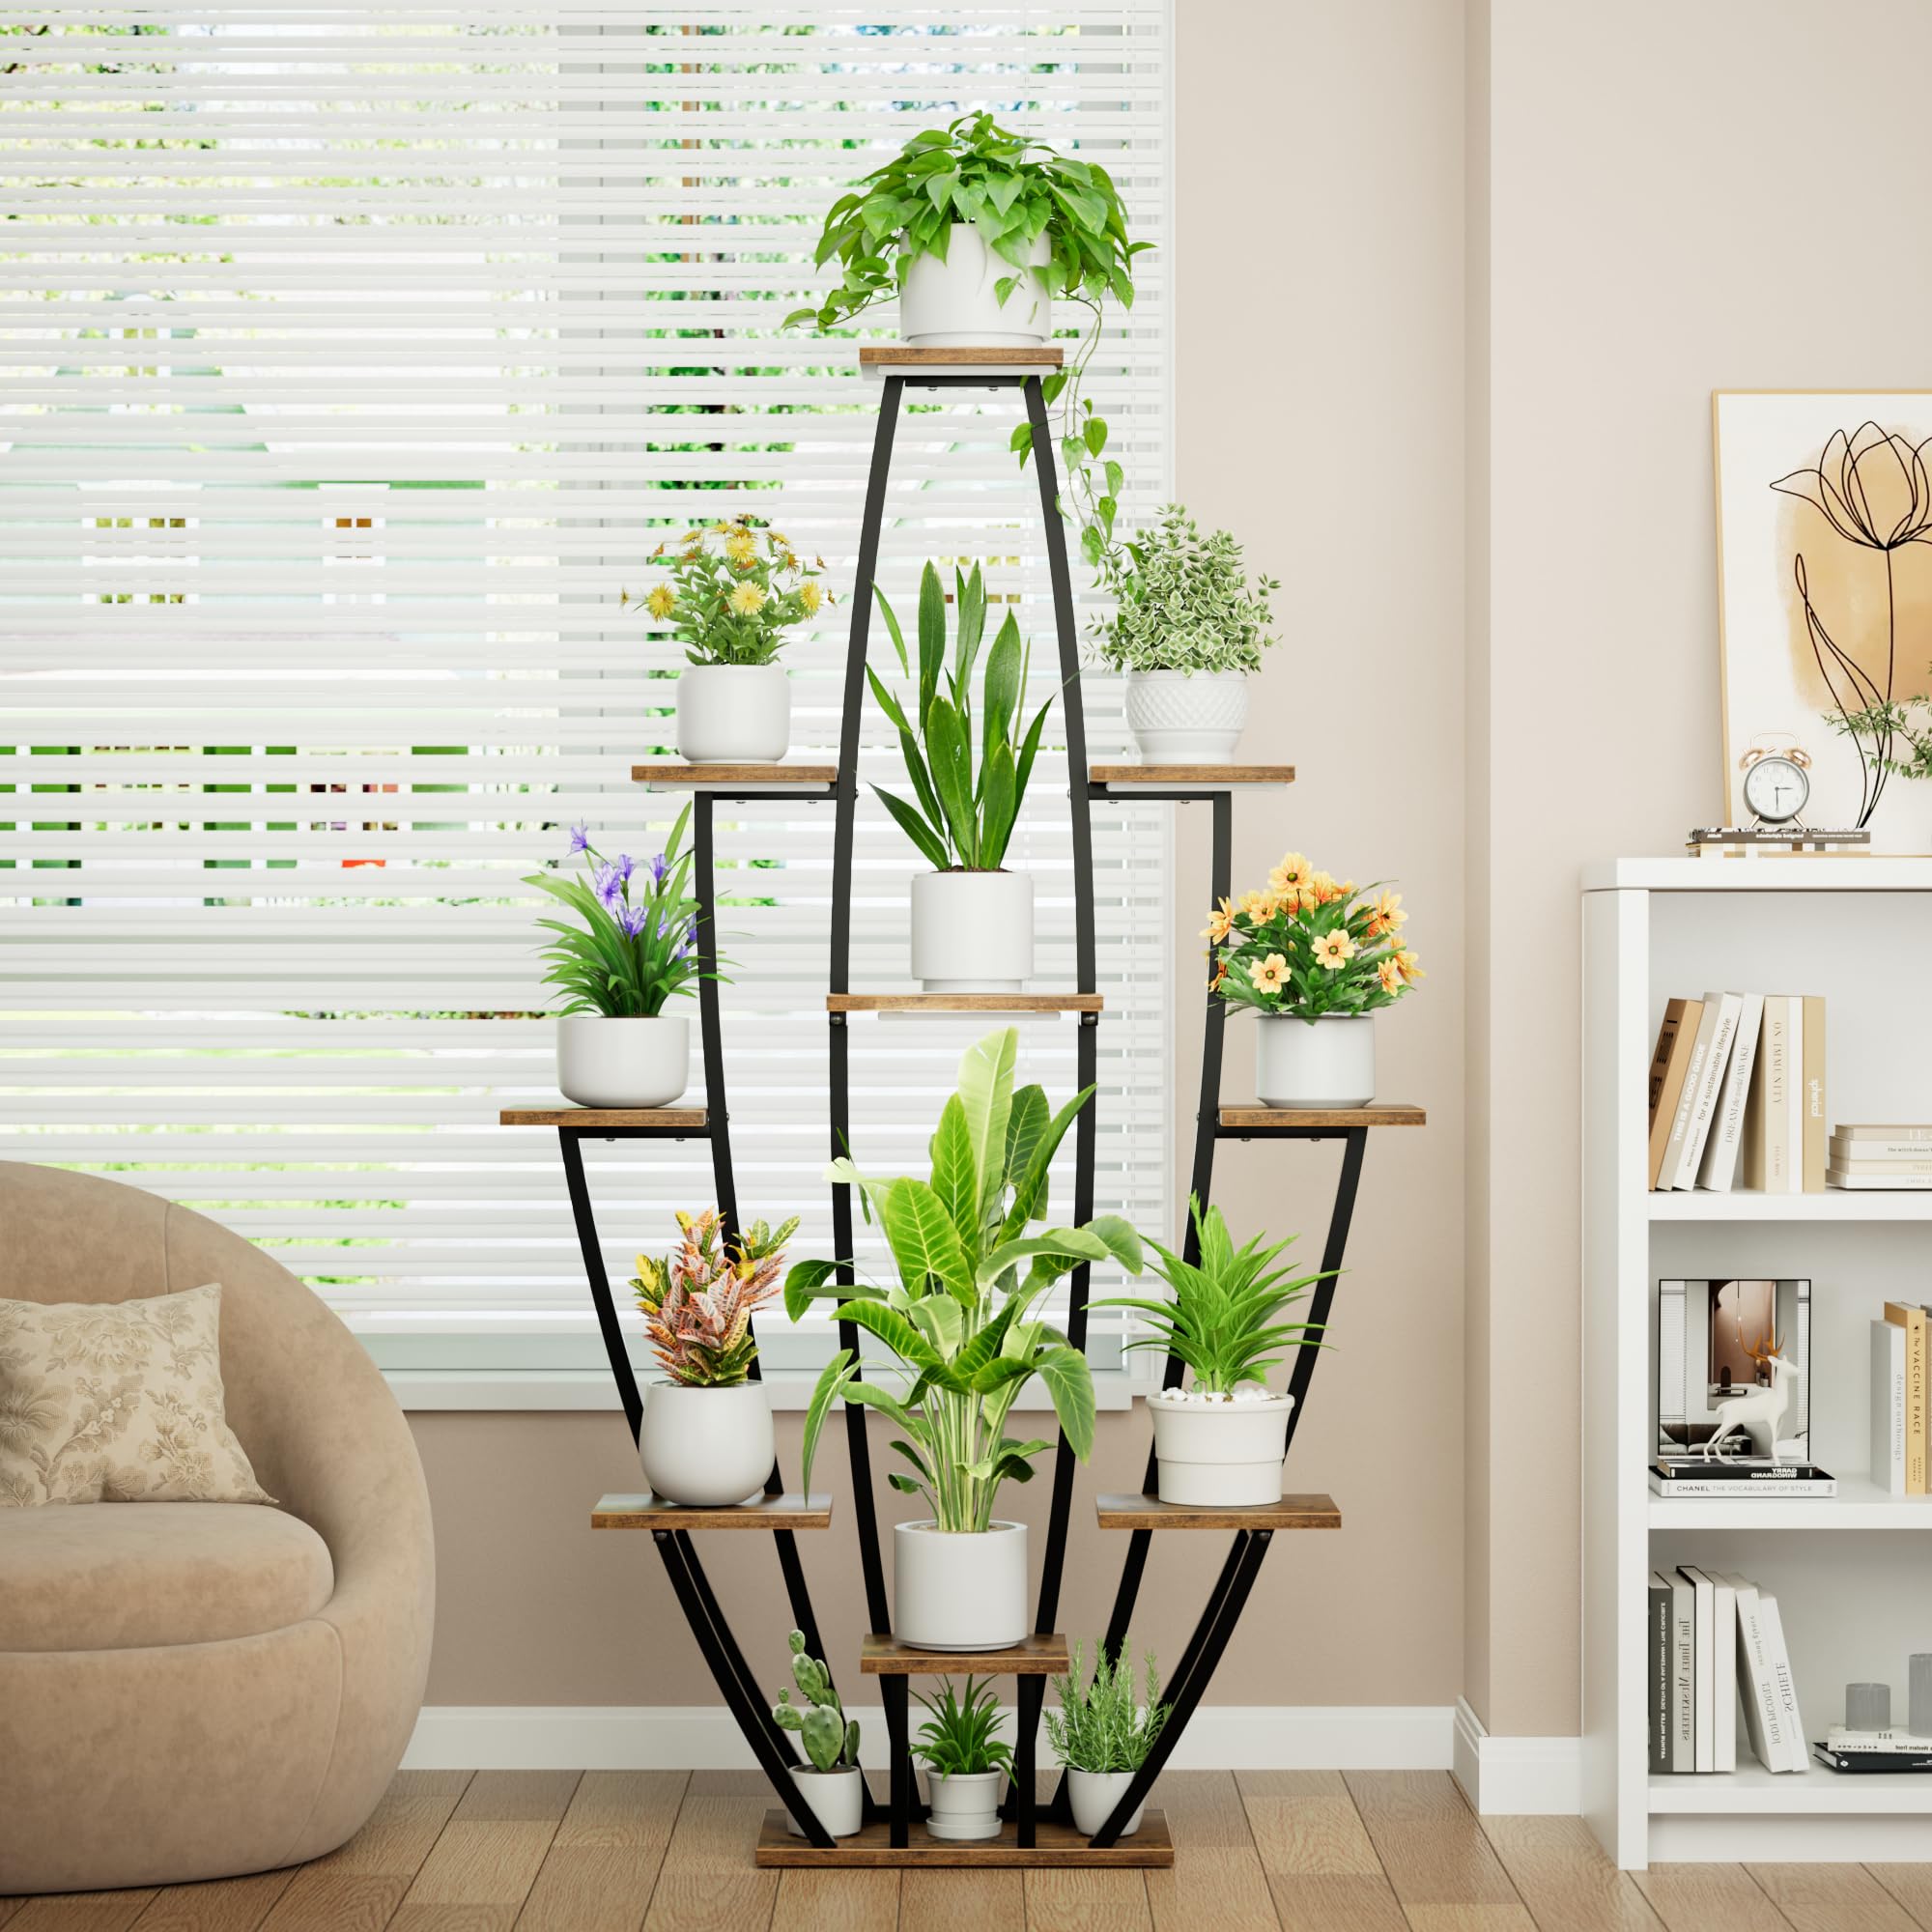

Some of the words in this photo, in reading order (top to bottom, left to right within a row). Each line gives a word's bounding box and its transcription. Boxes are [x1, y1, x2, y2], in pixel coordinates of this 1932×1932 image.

[1692, 1043, 1706, 1073] GUIDE
[1698, 1109, 1707, 1121] for
[1706, 1052, 1722, 1100] sustainable
[1717, 1018, 1732, 1051] lifestyle
[1685, 1073, 1697, 1101] GOOD
[1773, 1043, 1782, 1105] IMMUNITY
[1683, 1102, 1690, 1111] A
[1673, 1121, 1685, 1141] THIS
